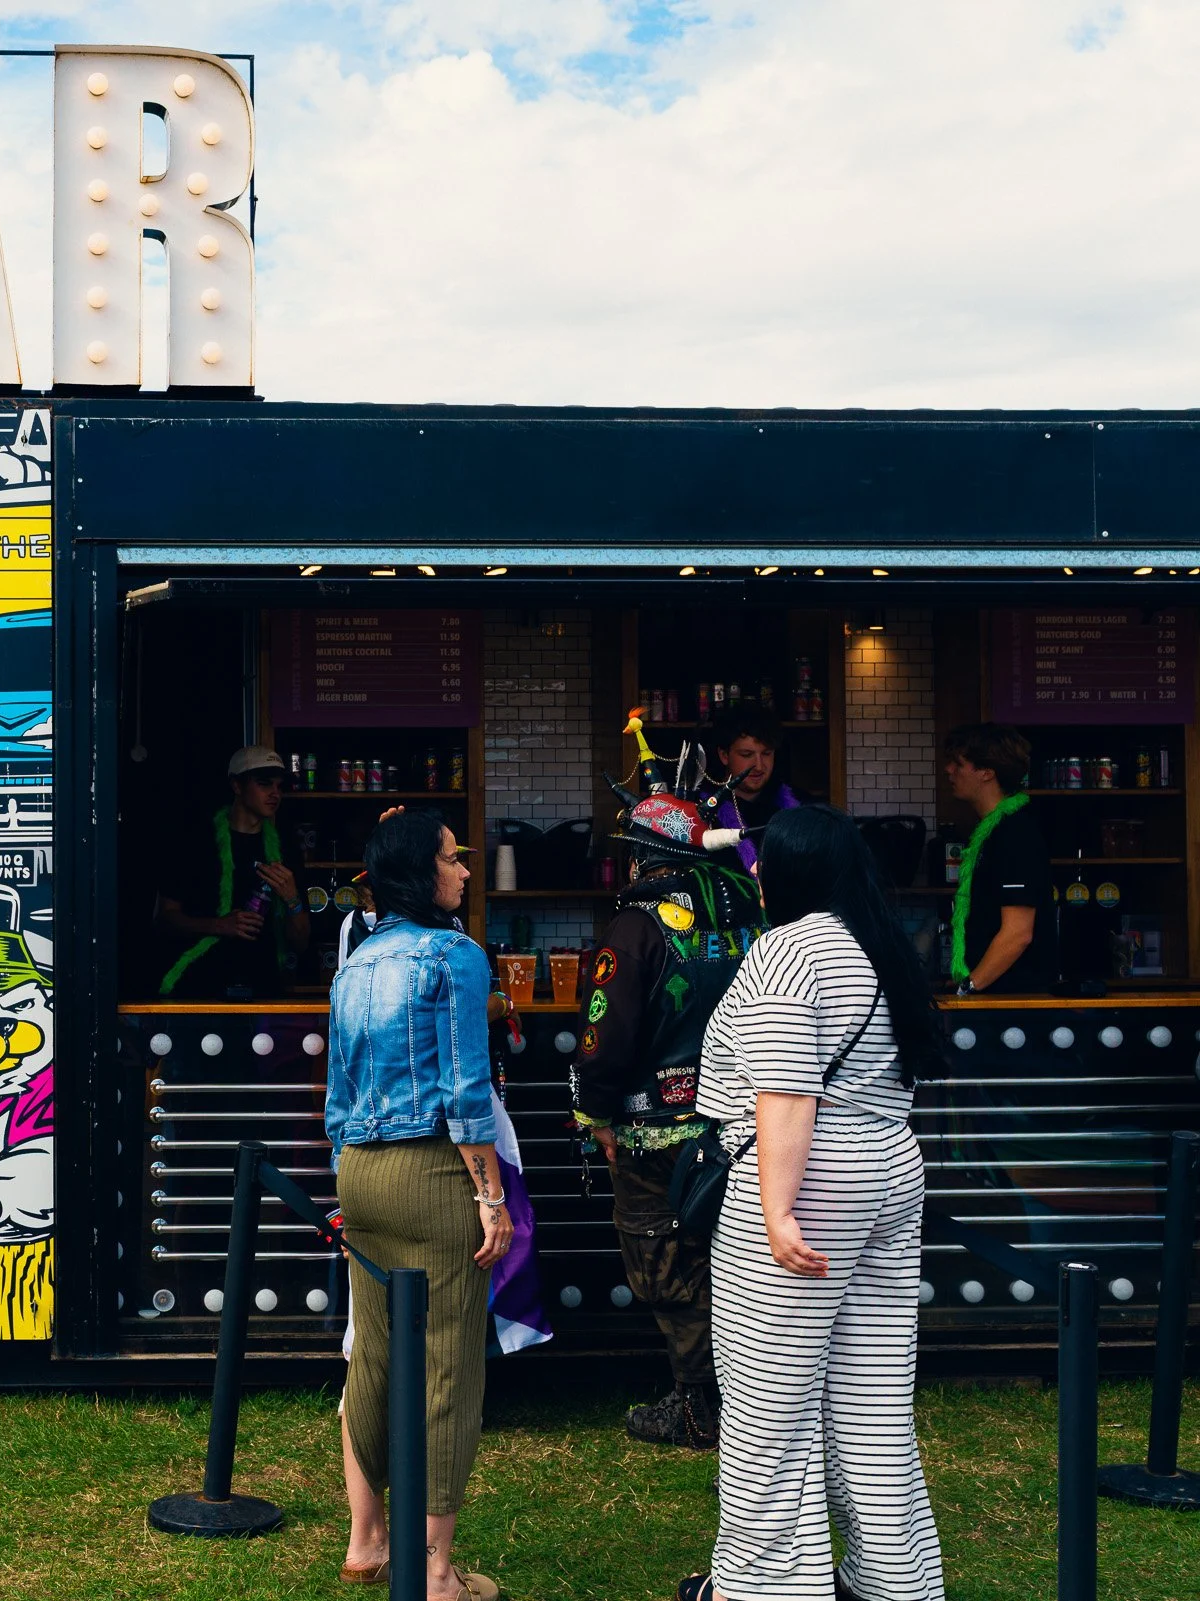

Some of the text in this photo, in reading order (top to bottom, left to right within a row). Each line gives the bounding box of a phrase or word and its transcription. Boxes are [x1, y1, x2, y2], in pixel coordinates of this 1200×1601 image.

[316, 617, 342, 626] SPIRIT
[352, 617, 379, 626] MIXER
[1036, 616, 1074, 624] HARBOUR
[1103, 616, 1127, 624] LAGER
[316, 633, 356, 641] ESPRESSO
[357, 633, 393, 641] MARTINI
[440, 633, 460, 641] 11.50
[1036, 631, 1080, 639] THATCHERS
[1081, 631, 1101, 639] GOLD
[355, 648, 393, 656] COCKTAIL
[440, 648, 460, 656] 11.50
[1036, 646, 1060, 654] LUCKY
[1061, 646, 1084, 654] SAINT
[316, 664, 345, 672] HOOCH
[442, 664, 461, 672] 6.95
[1036, 661, 1057, 669] WINE
[1036, 676, 1052, 684] RED
[1053, 676, 1073, 684] BULL
[343, 694, 367, 702] BOMB
[1036, 691, 1055, 699] SOFT
[1110, 691, 1137, 699] WATER
